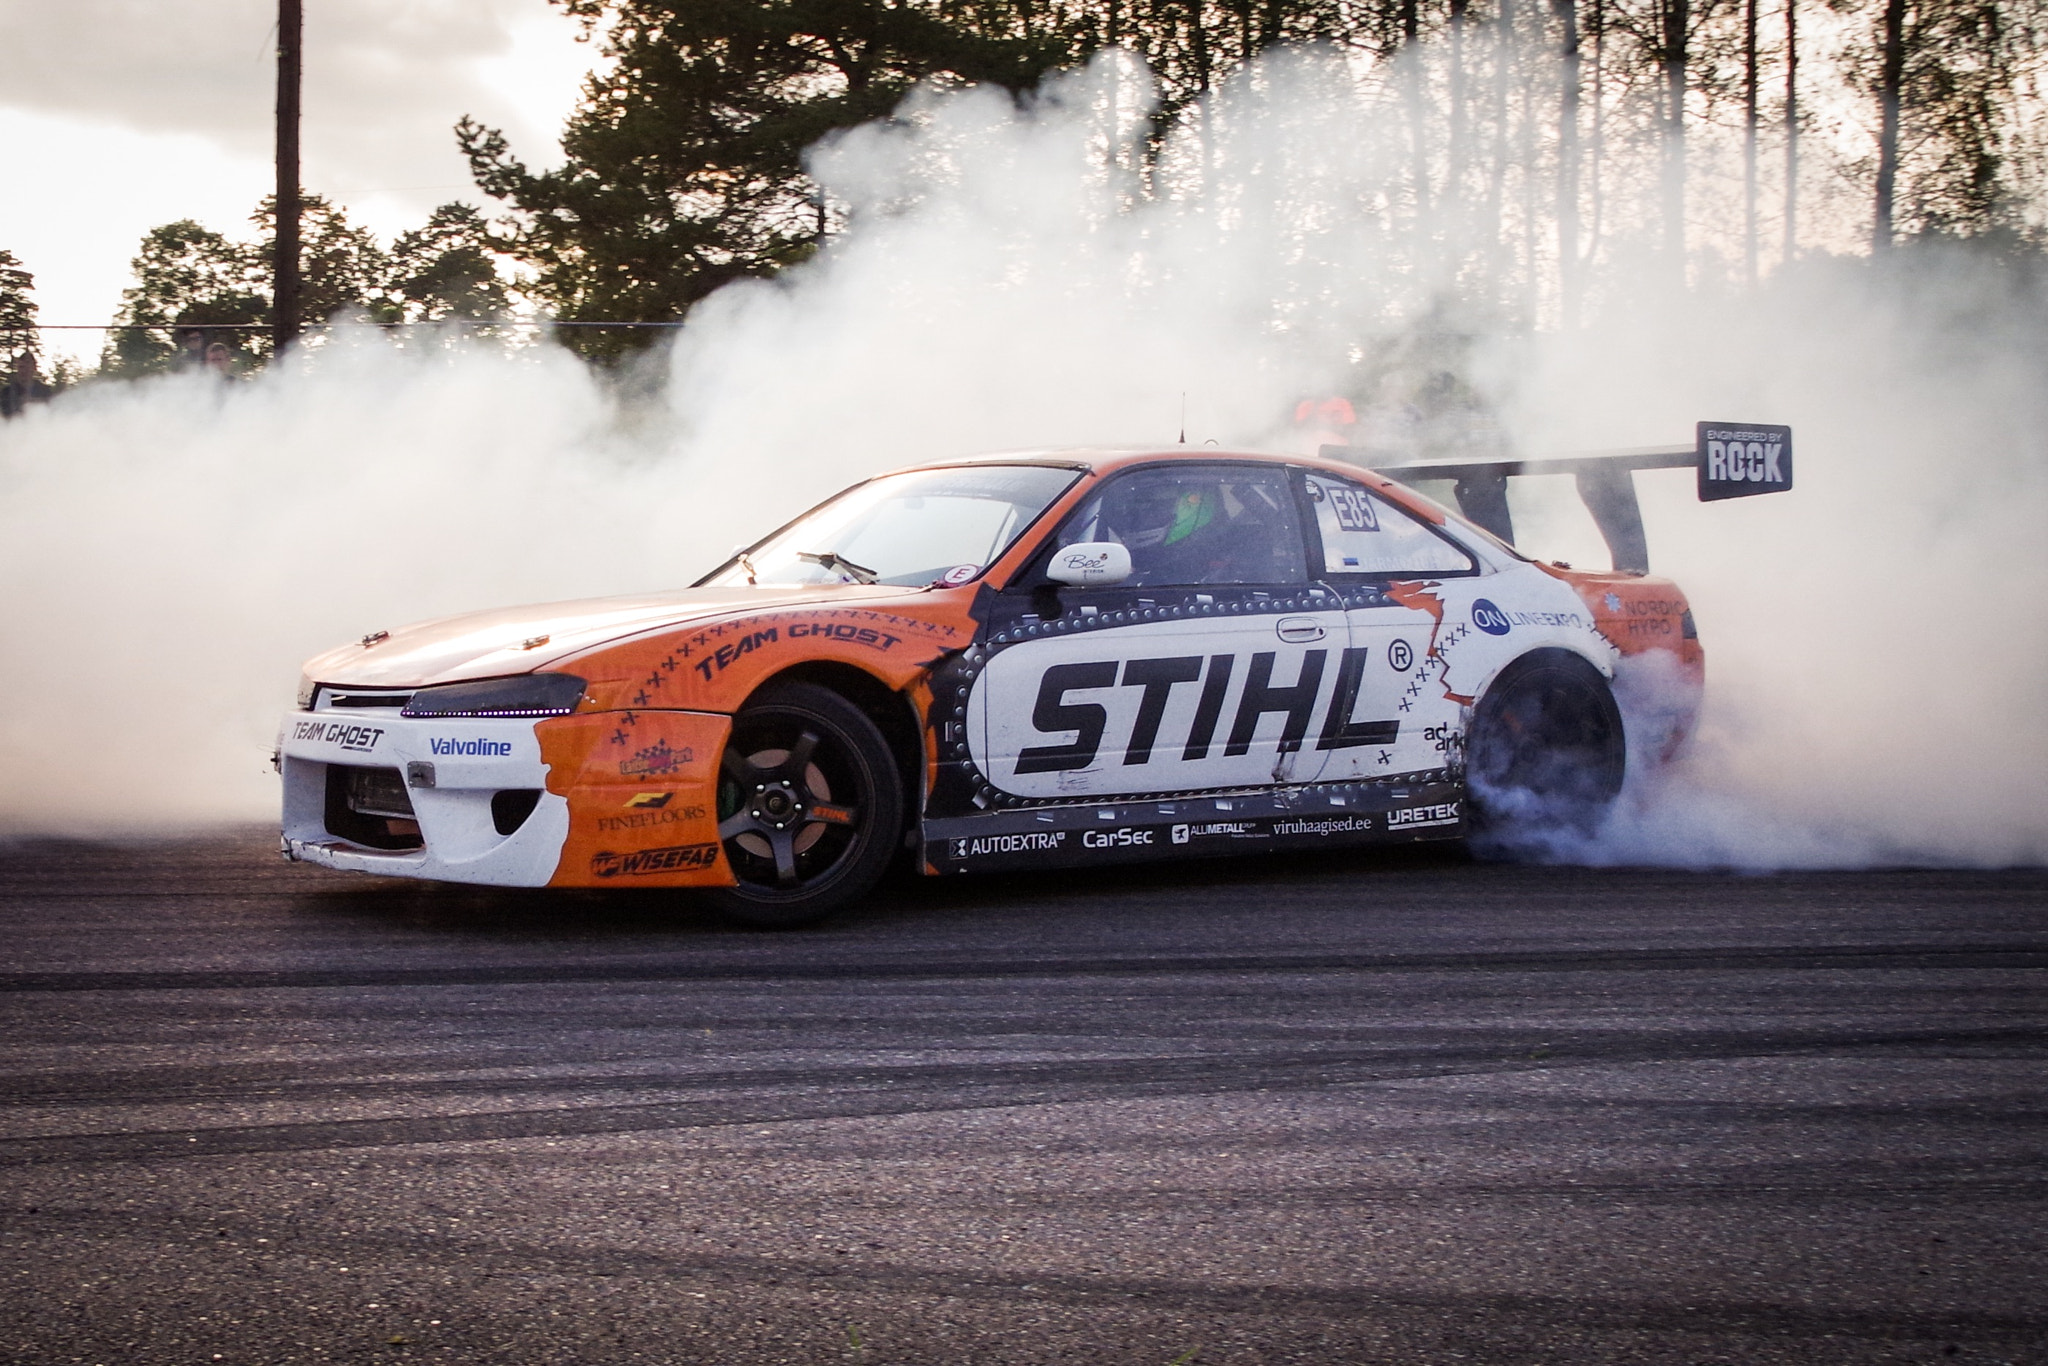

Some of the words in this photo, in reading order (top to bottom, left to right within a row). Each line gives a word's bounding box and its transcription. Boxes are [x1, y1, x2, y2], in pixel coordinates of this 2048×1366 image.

[1707, 430, 1767, 441] ENGINEERED
[1768, 433, 1782, 442] BY
[1708, 441, 1783, 482] ROCK
[1328, 489, 1376, 528] E85
[1064, 554, 1104, 569] Bee
[952, 568, 971, 579] E
[1624, 601, 1682, 616] NORDIC
[1628, 619, 1671, 635] HYPO
[694, 627, 778, 682] TEAM
[788, 623, 902, 650] GHOST
[1013, 647, 1400, 775] STIHL
[292, 722, 324, 741] TEAM
[325, 724, 385, 748] GHOST
[1423, 722, 1447, 741] ad
[1435, 732, 1464, 751] ark
[430, 738, 512, 756] Valvoline
[598, 804, 706, 831] FINEFLOORS
[1388, 802, 1459, 824] URETEK
[1273, 816, 1372, 836] viruhaagised.ee
[970, 833, 1058, 855] AUTOEXTRA
[622, 846, 719, 872] WISEFAB
